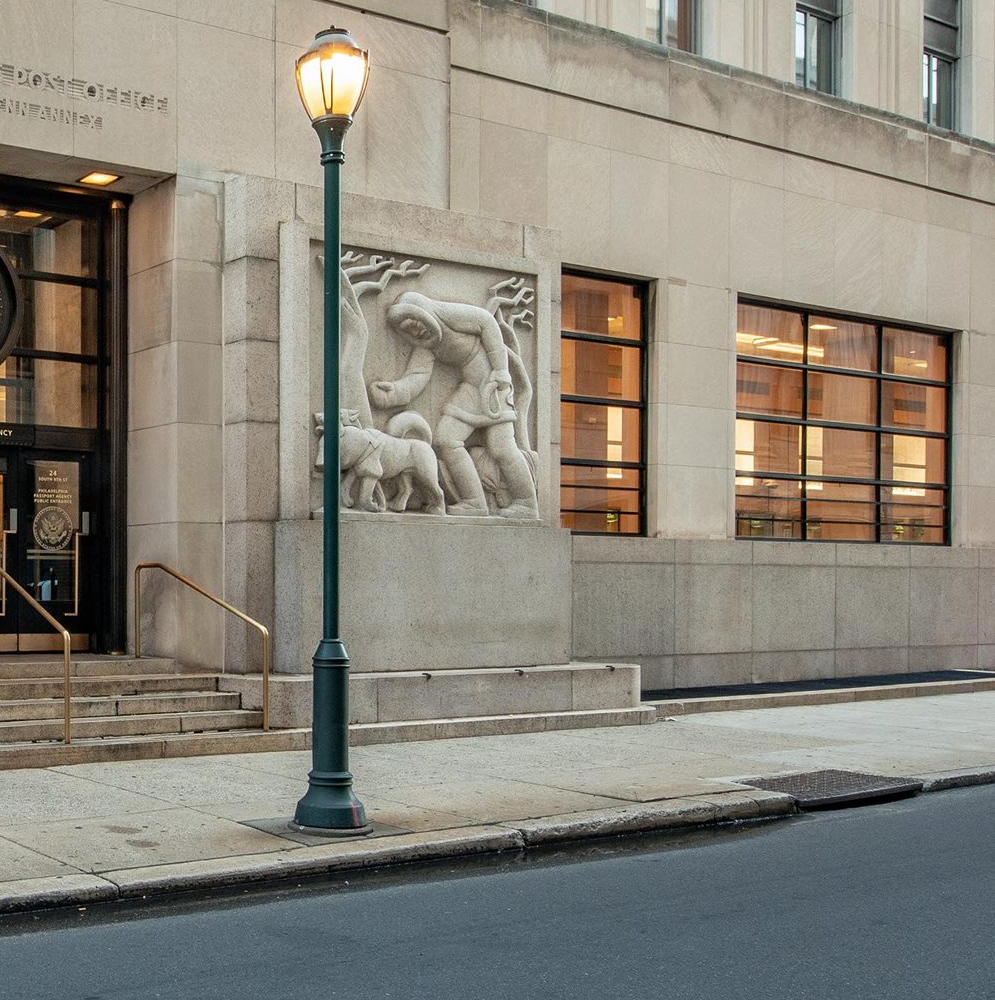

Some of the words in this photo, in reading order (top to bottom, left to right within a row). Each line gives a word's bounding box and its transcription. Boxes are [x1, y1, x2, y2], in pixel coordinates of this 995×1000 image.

[12, 66, 71, 98] POST
[82, 82, 169, 114] OFFICE
[40, 104, 103, 130] ANNEX
